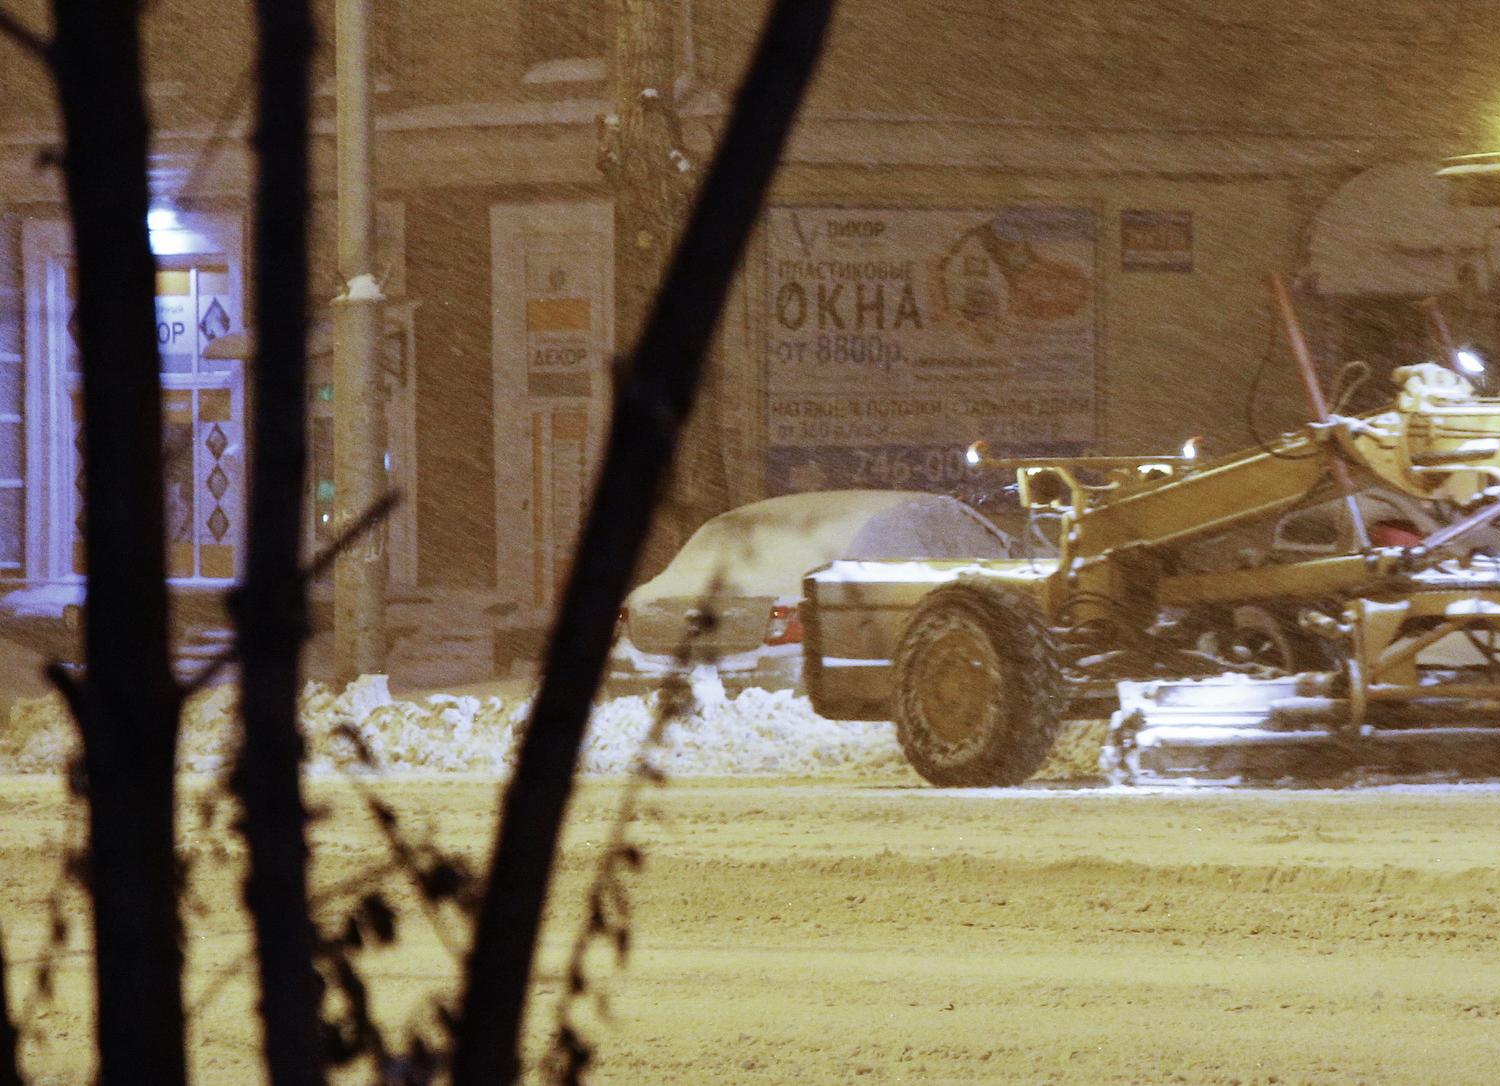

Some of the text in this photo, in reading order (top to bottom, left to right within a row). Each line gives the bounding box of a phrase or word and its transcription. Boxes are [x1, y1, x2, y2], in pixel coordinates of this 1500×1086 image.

[779, 260, 912, 281] ПЛАСТИКОВЫЕ
[777, 282, 923, 330] ОКНА
[534, 348, 587, 366] ДЕКОР
[777, 342, 807, 364] от
